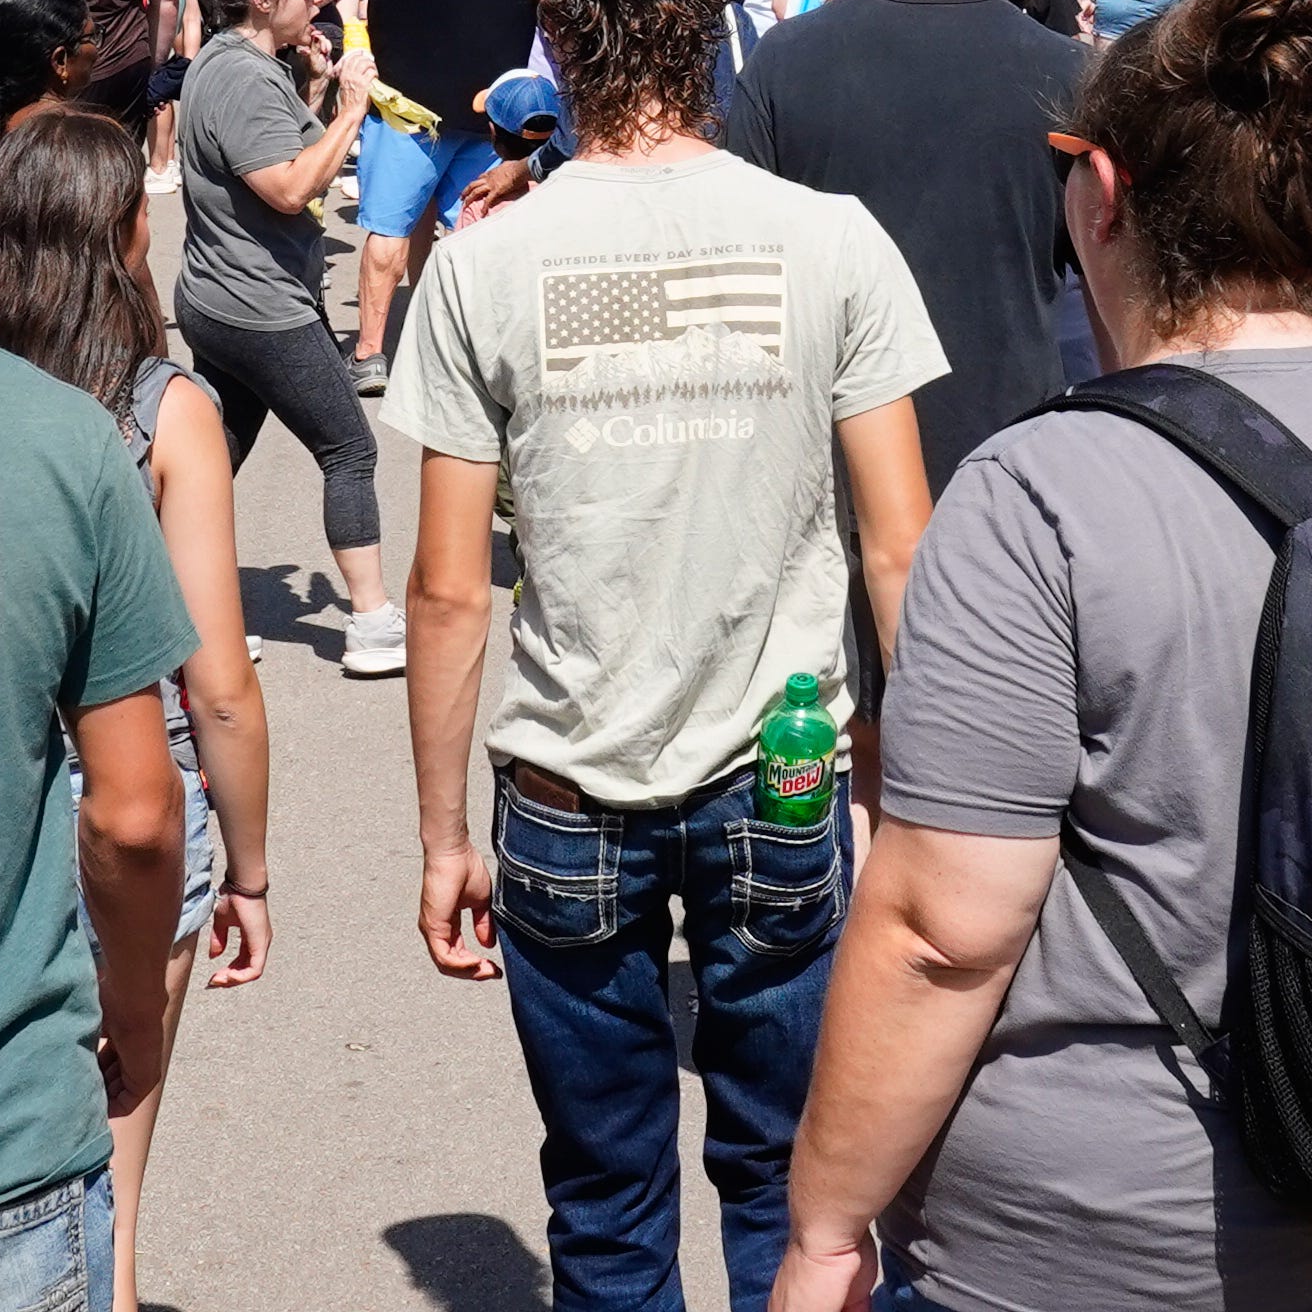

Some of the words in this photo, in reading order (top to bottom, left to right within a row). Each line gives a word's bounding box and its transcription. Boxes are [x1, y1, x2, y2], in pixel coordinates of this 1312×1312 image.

[542, 258, 607, 268] OUTSIDE
[615, 253, 660, 264] EVERY
[668, 249, 693, 260] DAY
[700, 244, 743, 256] SINCE
[602, 409, 754, 447] Columbia
